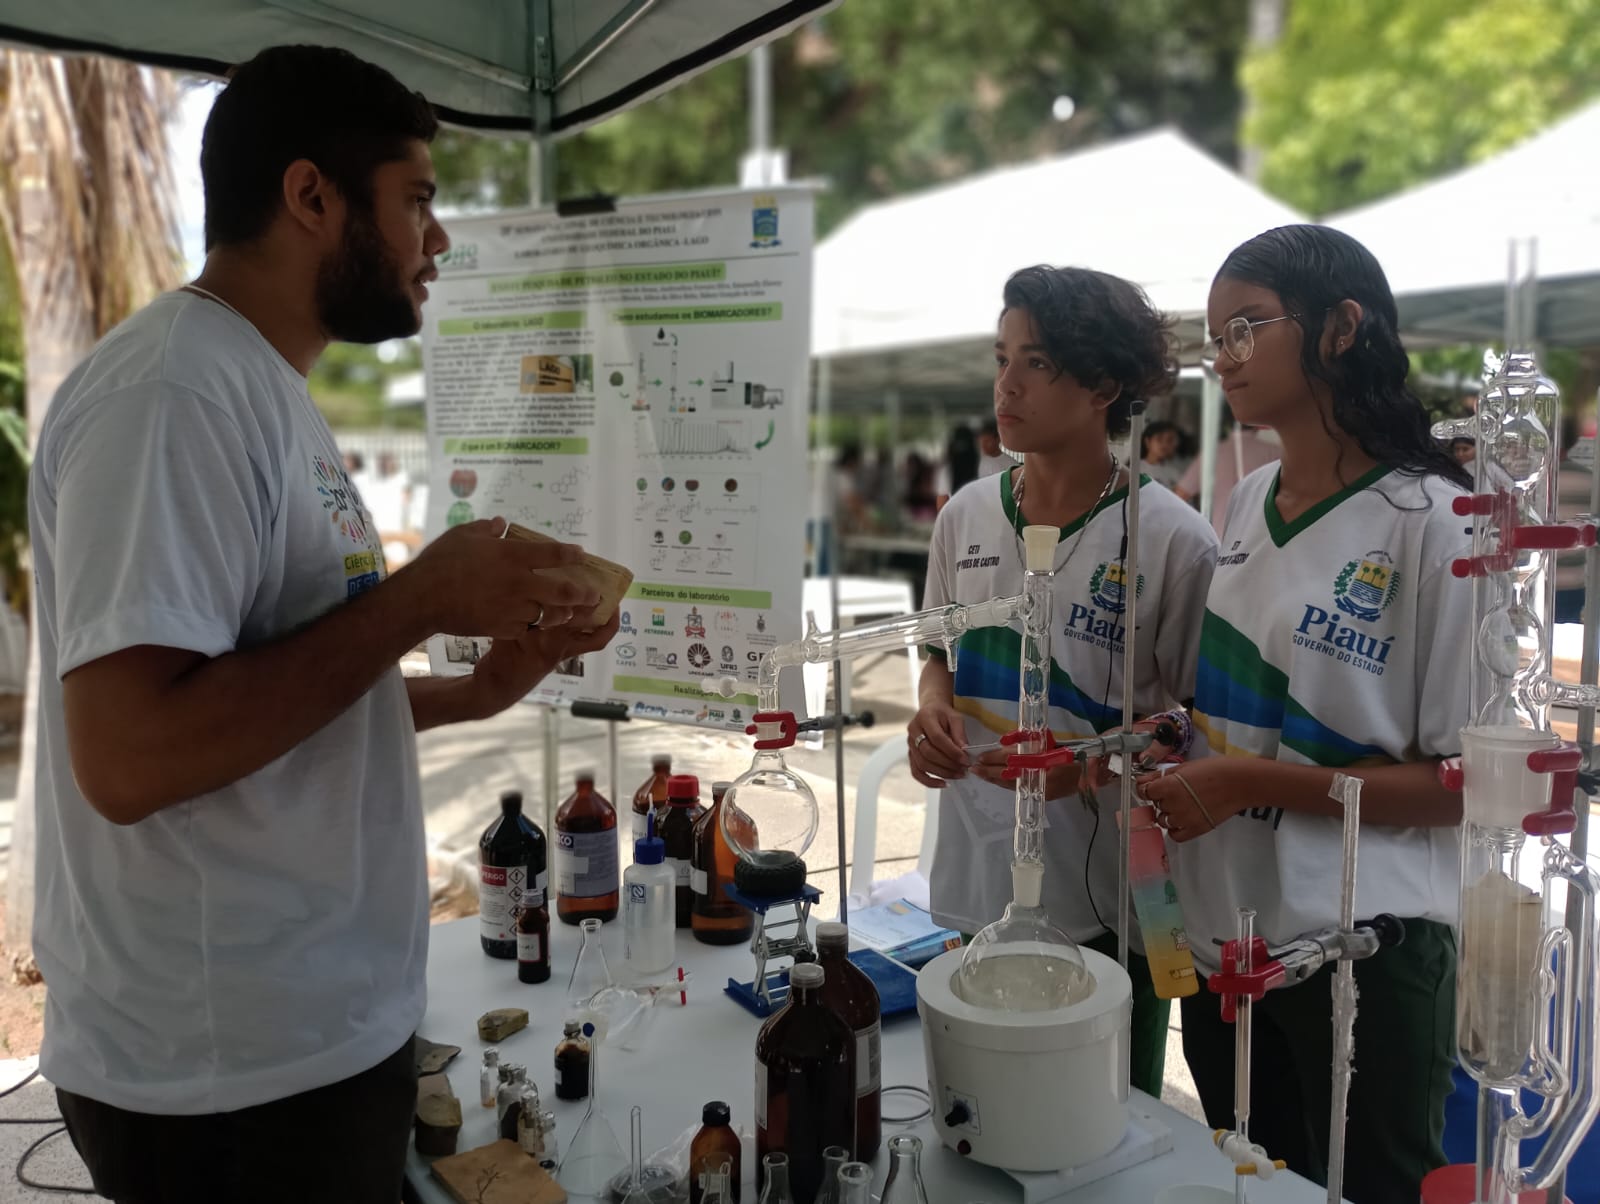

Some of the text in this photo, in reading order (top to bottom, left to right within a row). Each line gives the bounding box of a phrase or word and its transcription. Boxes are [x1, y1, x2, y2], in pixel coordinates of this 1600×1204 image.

[968, 544, 981, 555] CETI
[980, 555, 1000, 568] CASTRO
[641, 587, 730, 602] Parceiros do laboratório
[1063, 627, 1096, 644] GOVERNO
[1095, 638, 1106, 648] DO
[1295, 603, 1396, 665] Piauí
[1292, 633, 1385, 677] GOVERNO DO ESTADO
[481, 870, 505, 881] PERIGO
